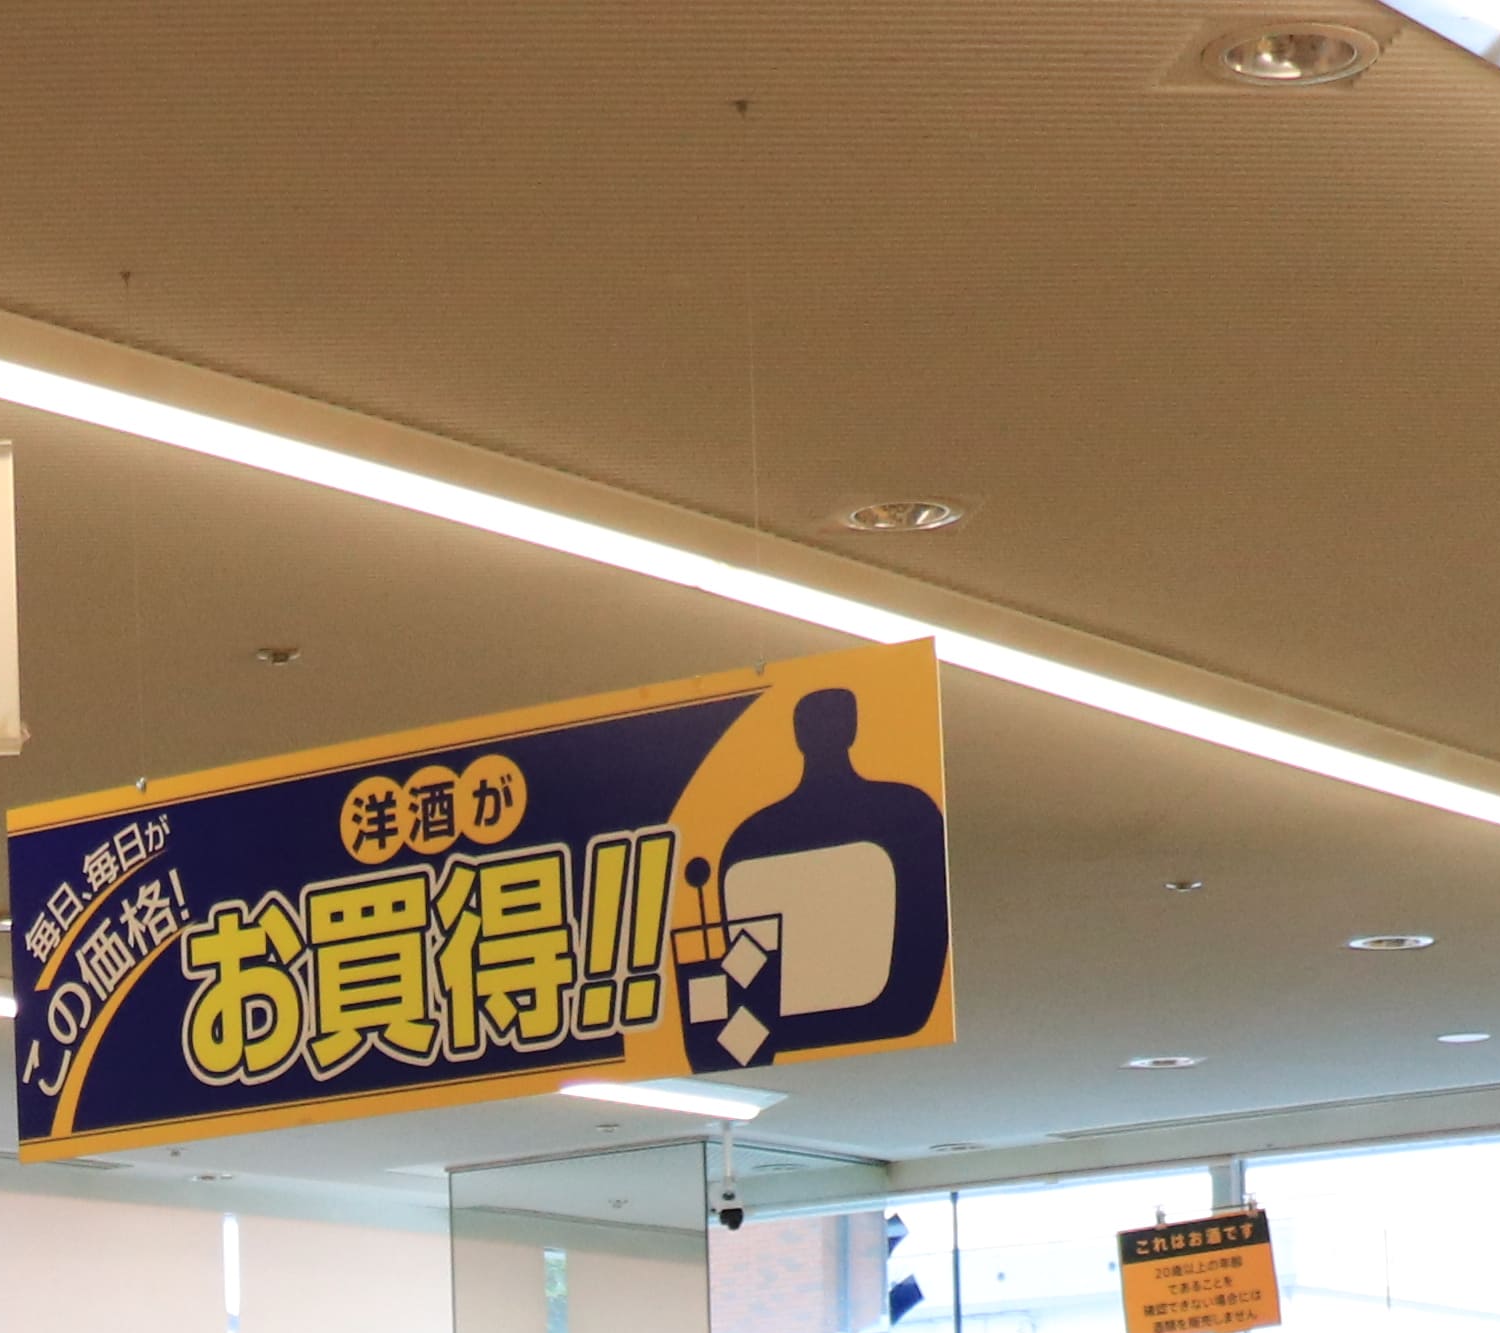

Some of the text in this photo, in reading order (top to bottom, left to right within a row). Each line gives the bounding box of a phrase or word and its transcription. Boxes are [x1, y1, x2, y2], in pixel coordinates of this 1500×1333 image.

[350, 772, 515, 854] 洋酒が
[23, 814, 171, 964] 毎日、毎日が
[1134, 1222, 1255, 1254] これはお酒です
[1154, 1257, 1243, 1280] 20歳以上の年齢
[1167, 1276, 1232, 1295] であることを
[1143, 1289, 1262, 1318] 確認できない場合には
